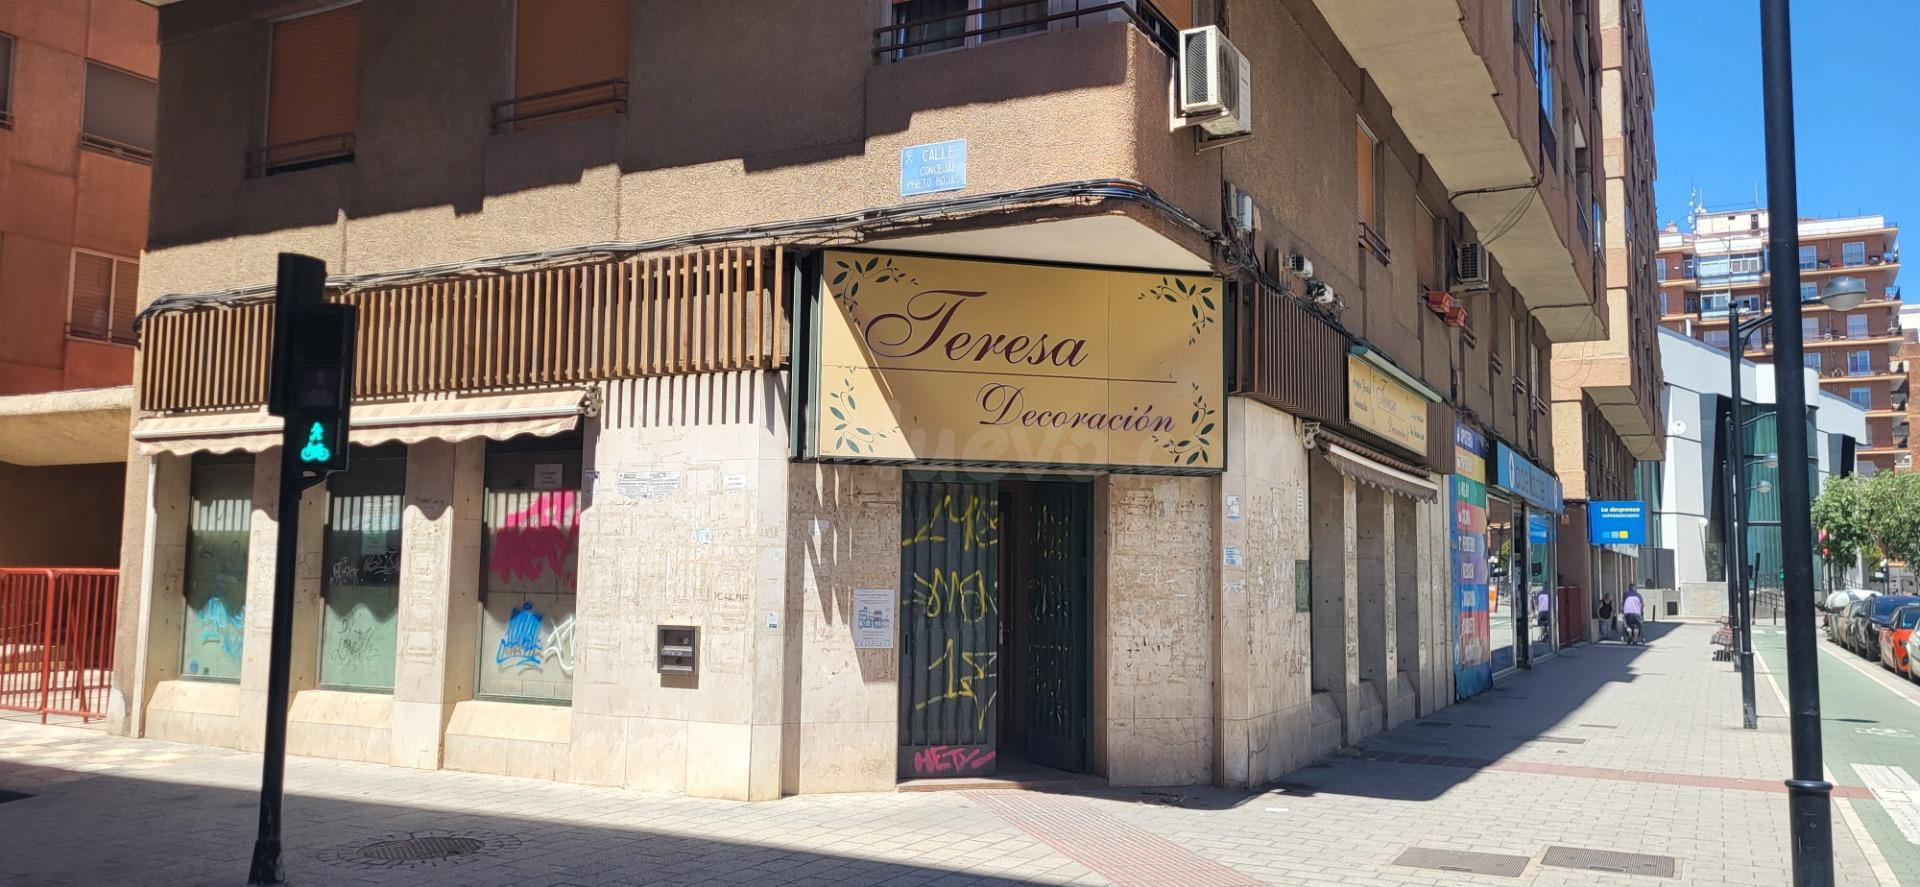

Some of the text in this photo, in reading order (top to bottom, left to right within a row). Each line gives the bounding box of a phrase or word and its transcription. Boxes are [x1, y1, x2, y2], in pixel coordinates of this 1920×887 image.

[922, 144, 957, 162] CALLE
[864, 289, 1089, 368] Teresa
[975, 382, 1176, 433] Decoración
